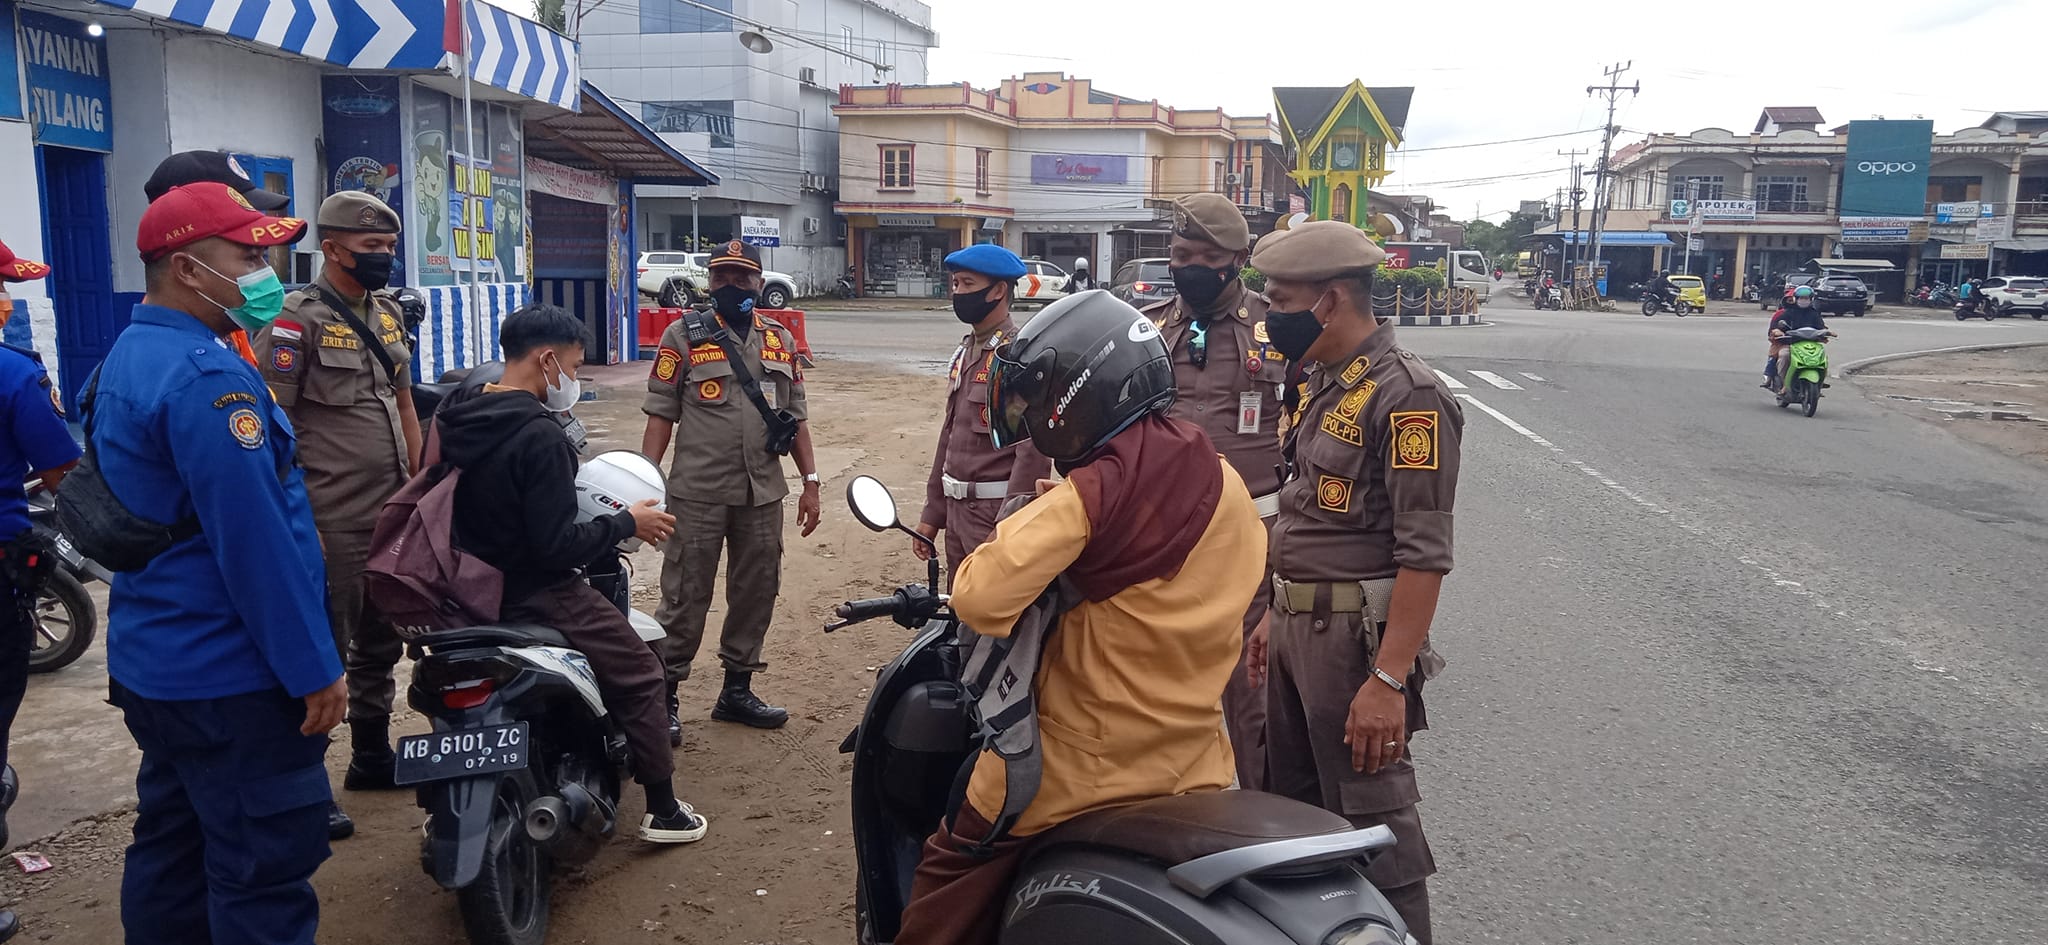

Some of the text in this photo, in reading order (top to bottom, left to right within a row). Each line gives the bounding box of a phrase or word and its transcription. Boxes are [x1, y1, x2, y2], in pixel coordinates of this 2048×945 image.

[32, 87, 104, 132] TILANG
[463, 197, 484, 228] AA
[1696, 201, 1746, 209] APOTEK
[743, 226, 760, 234] ANEKA
[453, 227, 494, 261] VASIN
[762, 350, 791, 362] POL PP
[1324, 417, 1359, 441] POL-PP
[598, 495, 625, 511] GM
[403, 728, 521, 759] KB 6101 ZC
[1010, 873, 1101, 922] Stylish
[1319, 888, 1358, 901] HONDA
